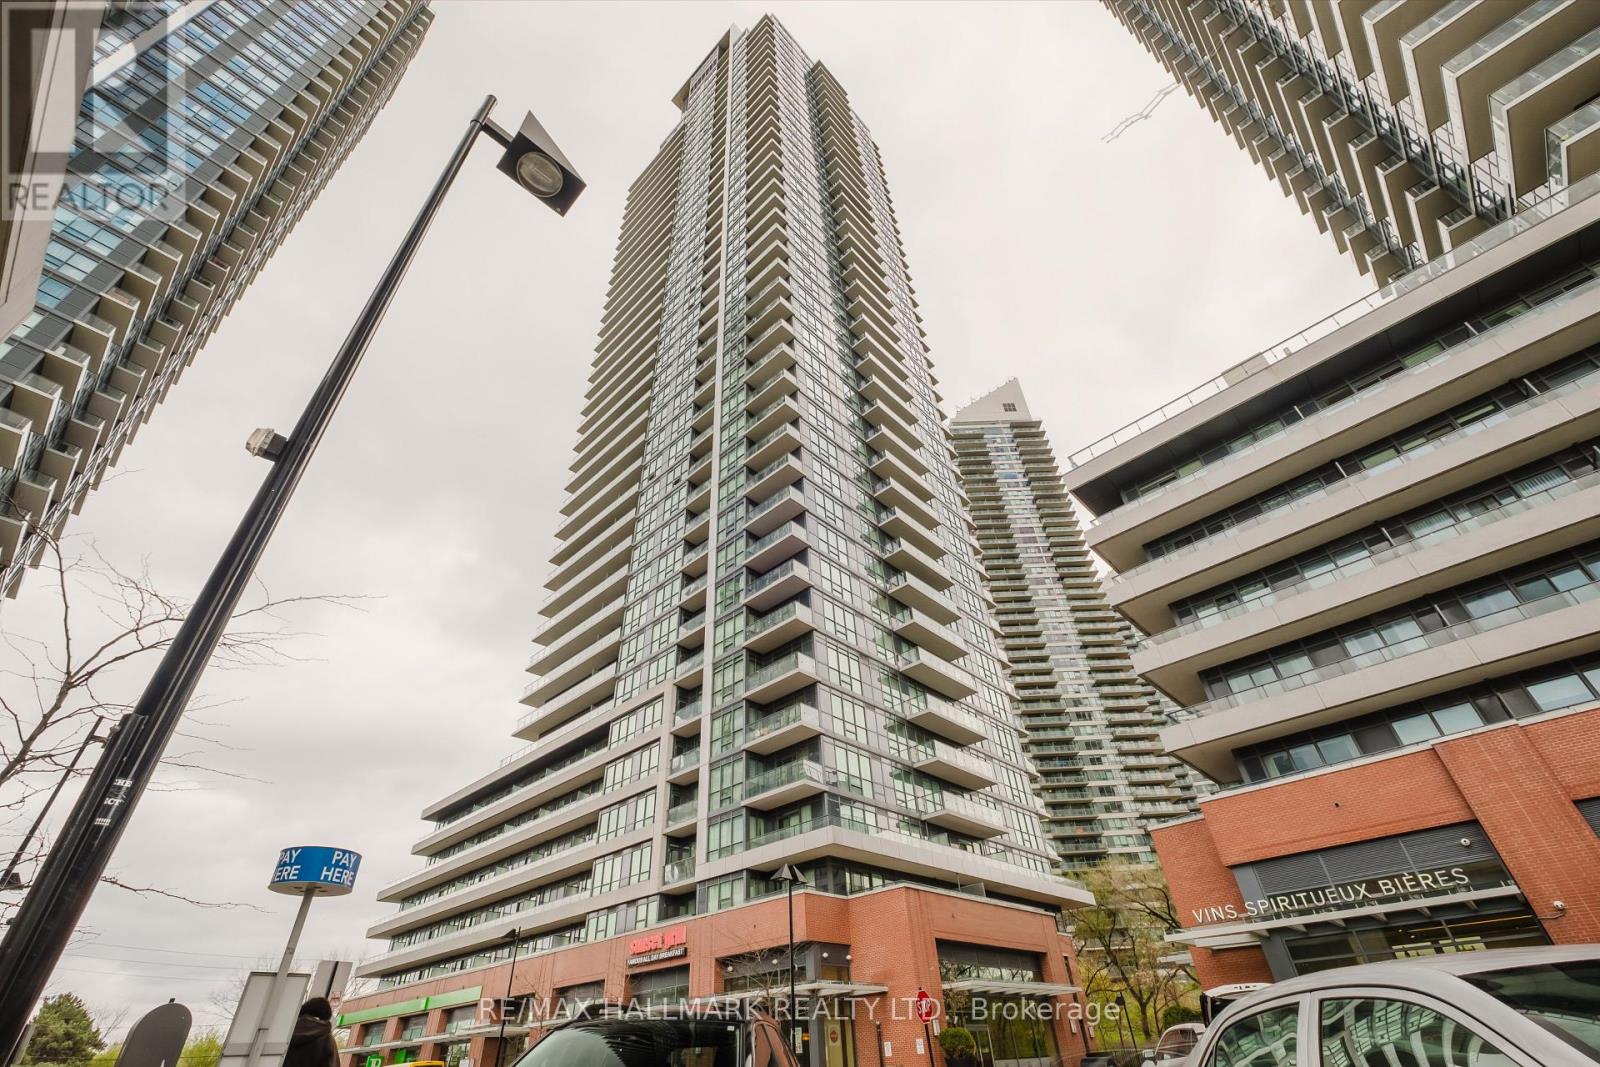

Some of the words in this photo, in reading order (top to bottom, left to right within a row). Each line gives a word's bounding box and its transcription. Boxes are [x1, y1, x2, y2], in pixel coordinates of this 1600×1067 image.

[279, 848, 302, 864] PAY
[331, 851, 357, 868] PAY
[273, 865, 301, 882] ERE
[320, 866, 354, 885] HERE
[1192, 905, 1238, 924] VINS
[1245, 884, 1373, 916] SPIRITUEUX
[1378, 868, 1470, 896] BIÈRES
[916, 998, 932, 1014] STOP
